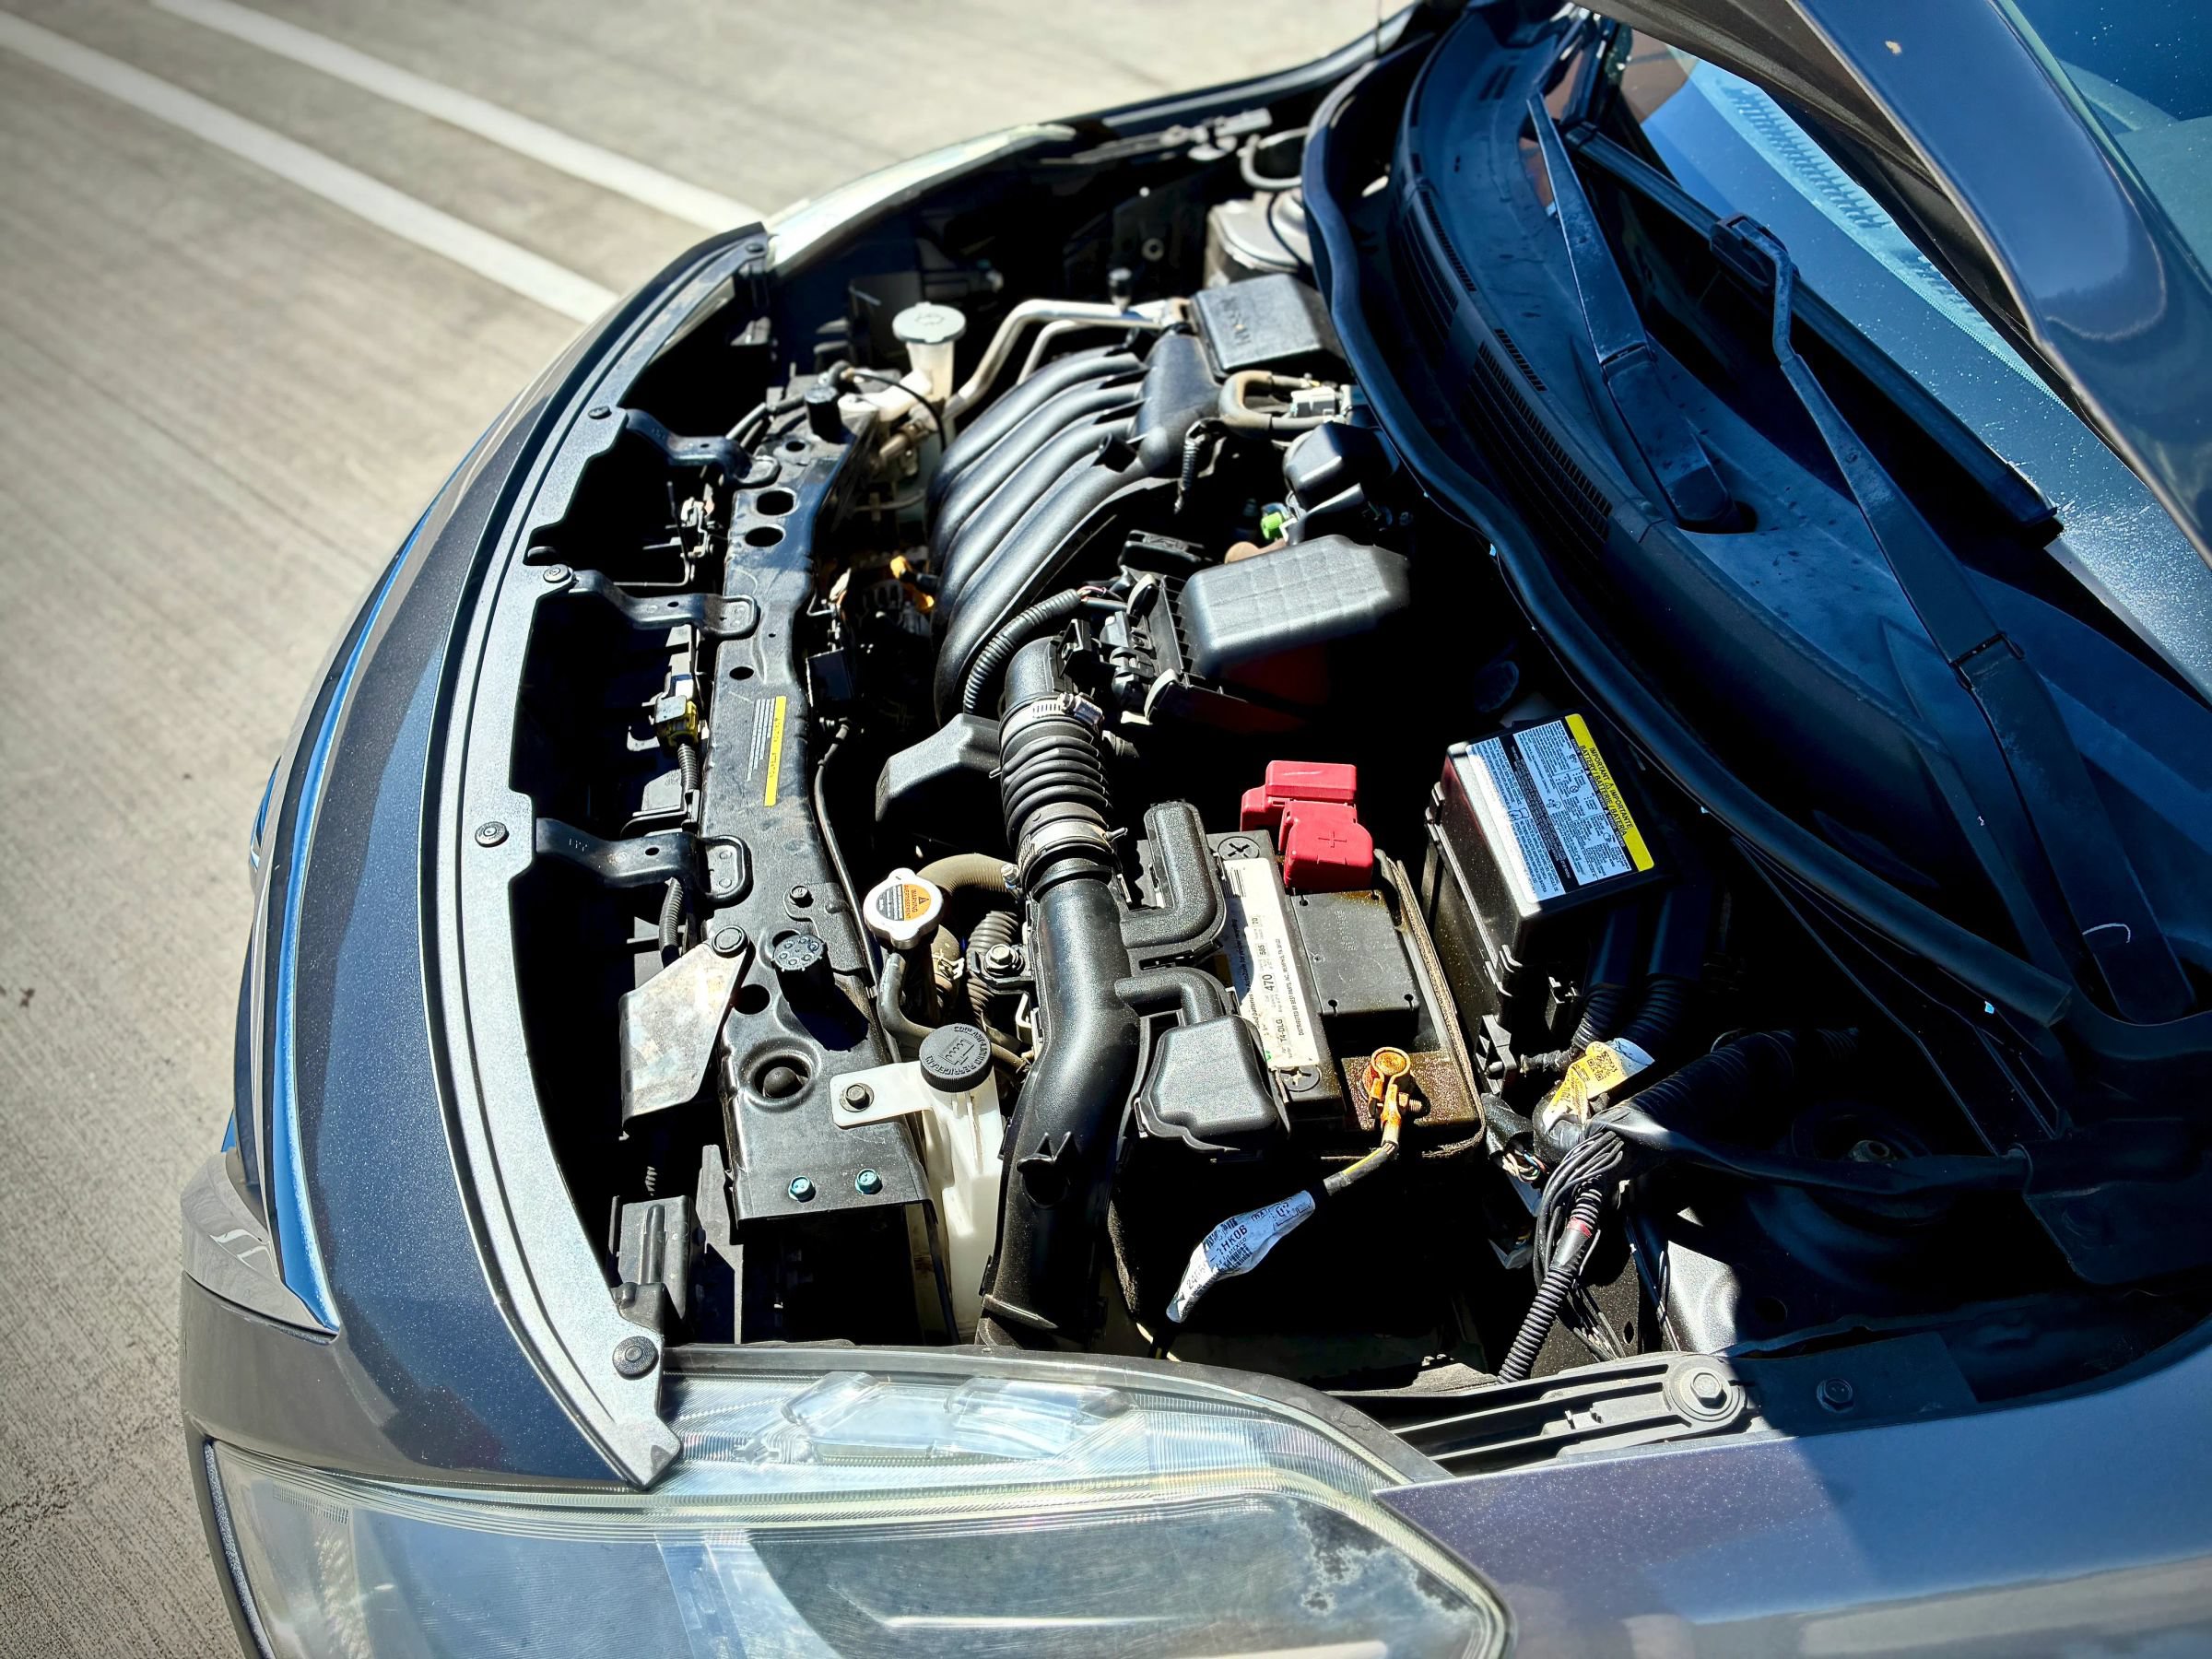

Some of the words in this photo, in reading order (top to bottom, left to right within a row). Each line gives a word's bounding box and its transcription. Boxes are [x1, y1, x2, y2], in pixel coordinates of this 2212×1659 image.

[1578, 744, 1597, 772] BATTERY
[1593, 774, 1613, 806] BATTERIE
[1588, 747, 1610, 781] IMPORTANT
[1608, 788, 1633, 829] IMPORTANTE
[1261, 972, 1276, 993] 470
